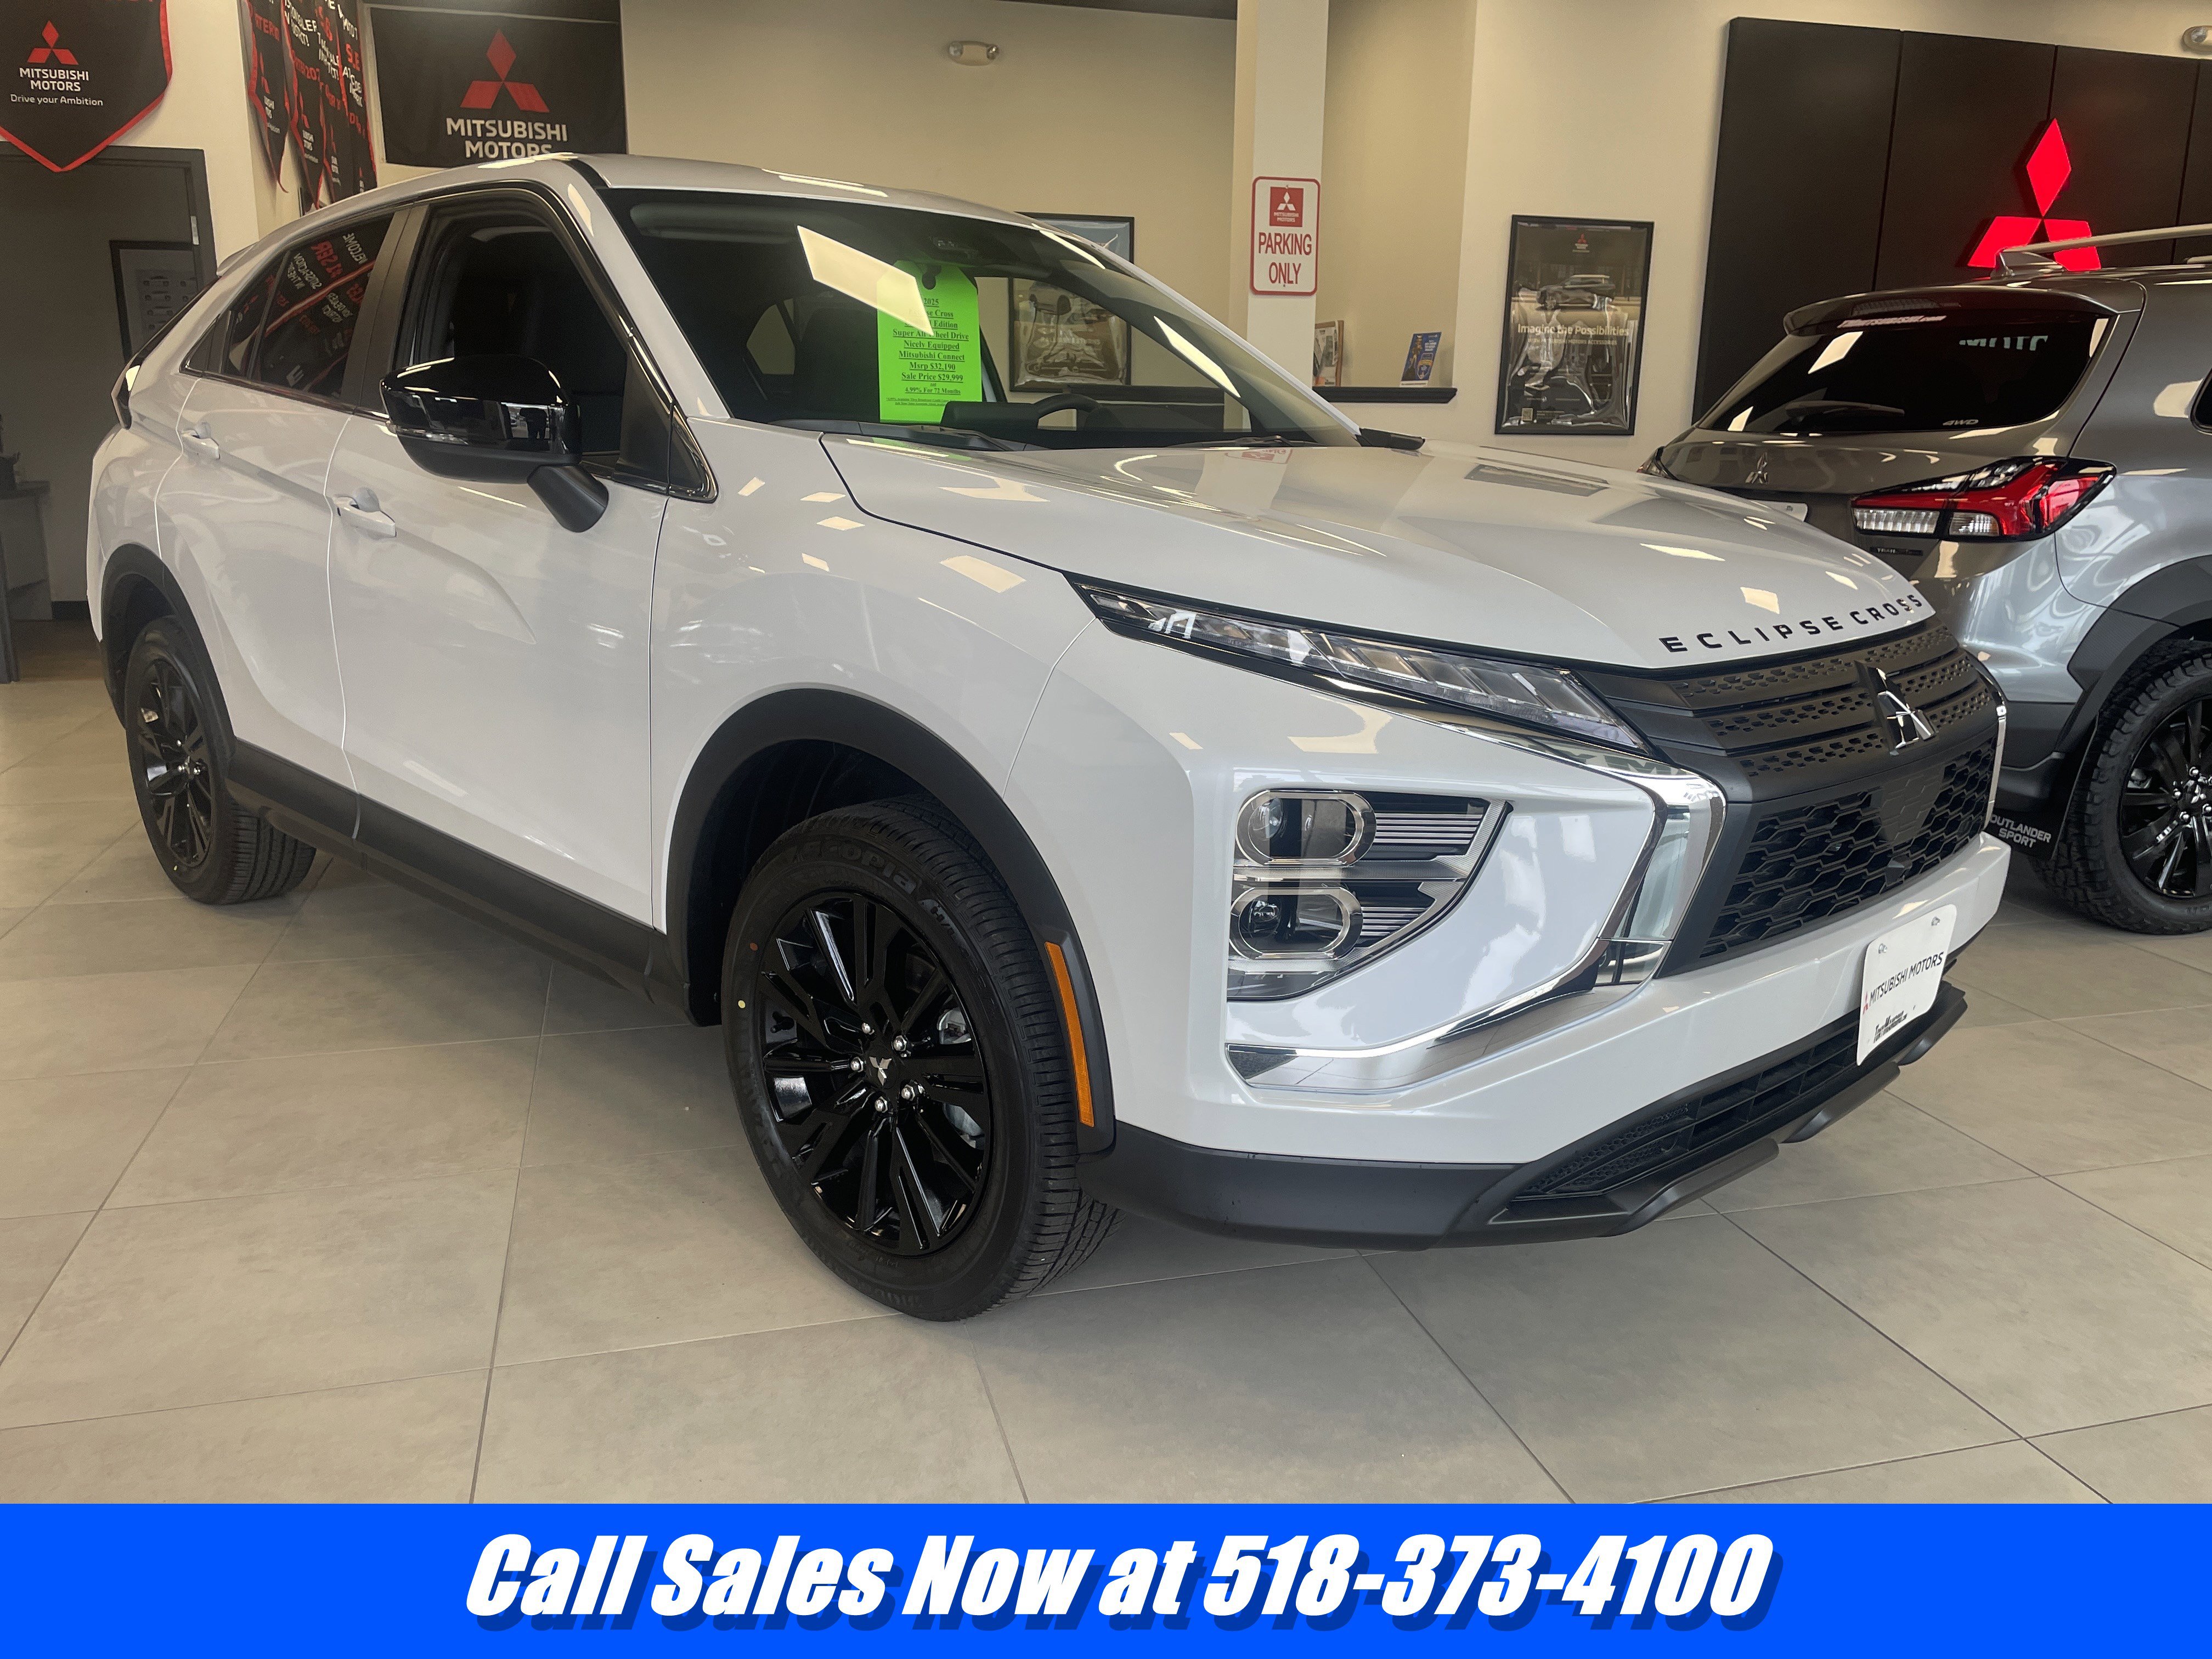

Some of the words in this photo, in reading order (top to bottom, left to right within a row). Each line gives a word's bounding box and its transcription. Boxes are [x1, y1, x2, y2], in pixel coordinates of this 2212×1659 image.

[19, 67, 90, 81] MITSUBISHI
[30, 80, 81, 92] MOTORS
[10, 94, 36, 104] Drive
[37, 97, 59, 105] your
[60, 96, 104, 106] Ambition
[445, 117, 568, 142] MITSUBISHI
[1258, 232, 1312, 256] PARKING
[1268, 262, 1301, 284] ONLY
[923, 297, 939, 306] 2025
[935, 309, 954, 318] Cross
[893, 329, 913, 337] Super
[951, 332, 969, 340] Drive
[1517, 323, 1555, 336] Imagine
[1575, 325, 1630, 337] Possibilities
[904, 340, 926, 348] Nicely
[927, 341, 960, 351] Equipped
[899, 350, 936, 359] Mitsubishi
[937, 352, 965, 361] Connect
[909, 362, 928, 371] Msrp
[930, 363, 956, 371] $32,190
[901, 372, 916, 380] Sale
[938, 374, 964, 382] $29,999
[1658, 616, 1844, 653] ECLIPSE
[1849, 594, 1923, 625] CROSS
[1990, 813, 2052, 843] OUTLANDER
[1998, 828, 2037, 849] SPORT
[1869, 968, 1908, 1007] MITSUBISHI
[1908, 951, 1945, 980] MOTORS
